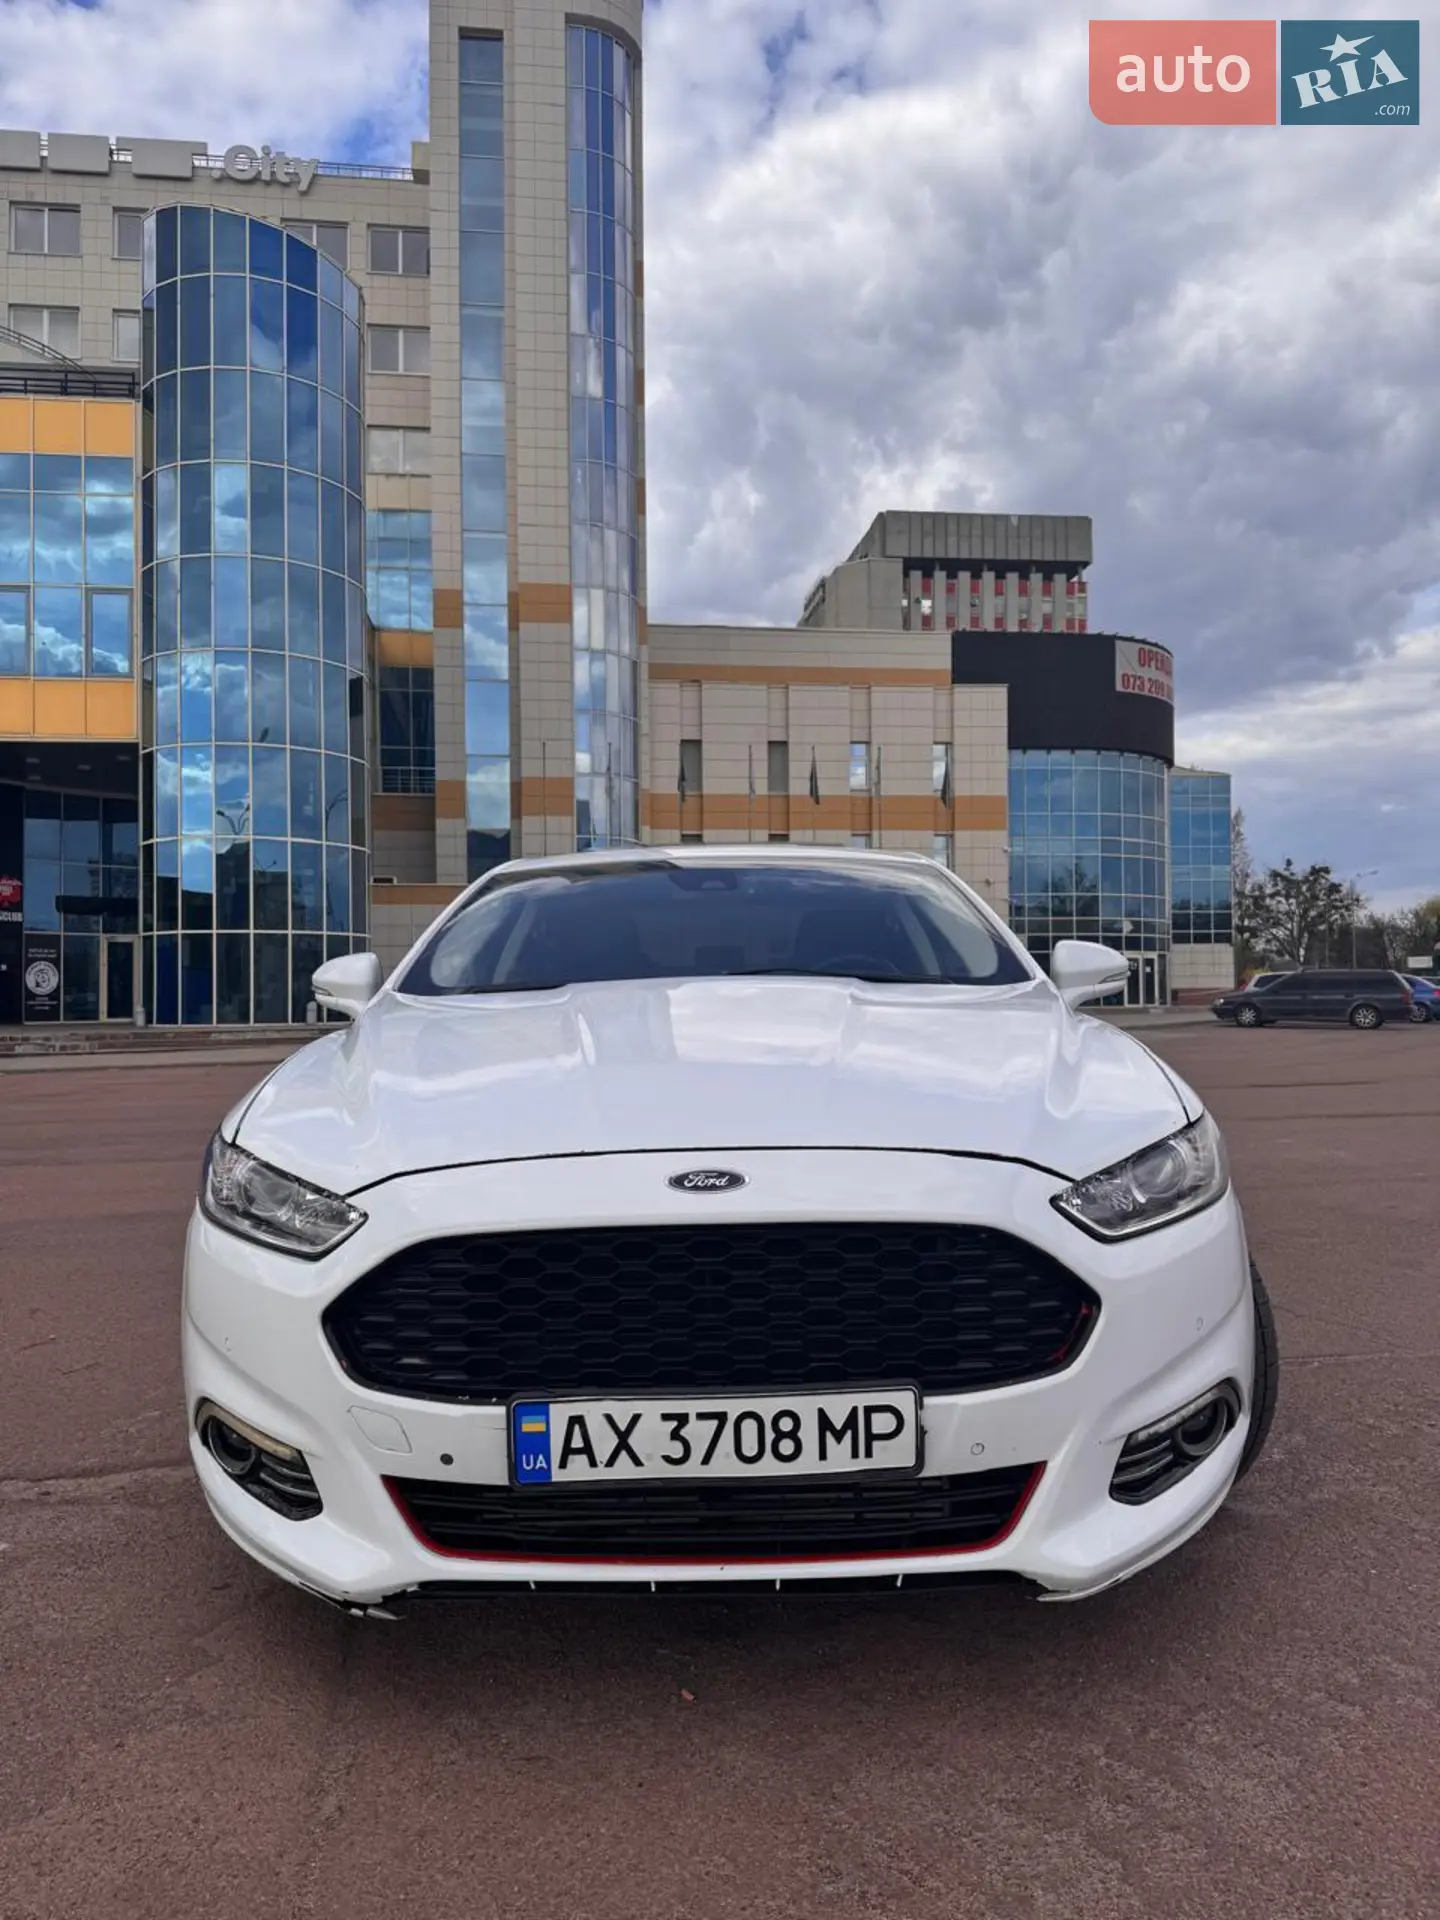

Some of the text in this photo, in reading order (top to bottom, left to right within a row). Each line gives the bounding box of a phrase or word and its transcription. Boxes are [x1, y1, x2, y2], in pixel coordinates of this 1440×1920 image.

[683, 1172, 730, 1188] Ford
[558, 1404, 906, 1469] AX 3708 MP
[521, 1454, 548, 1470] UA
